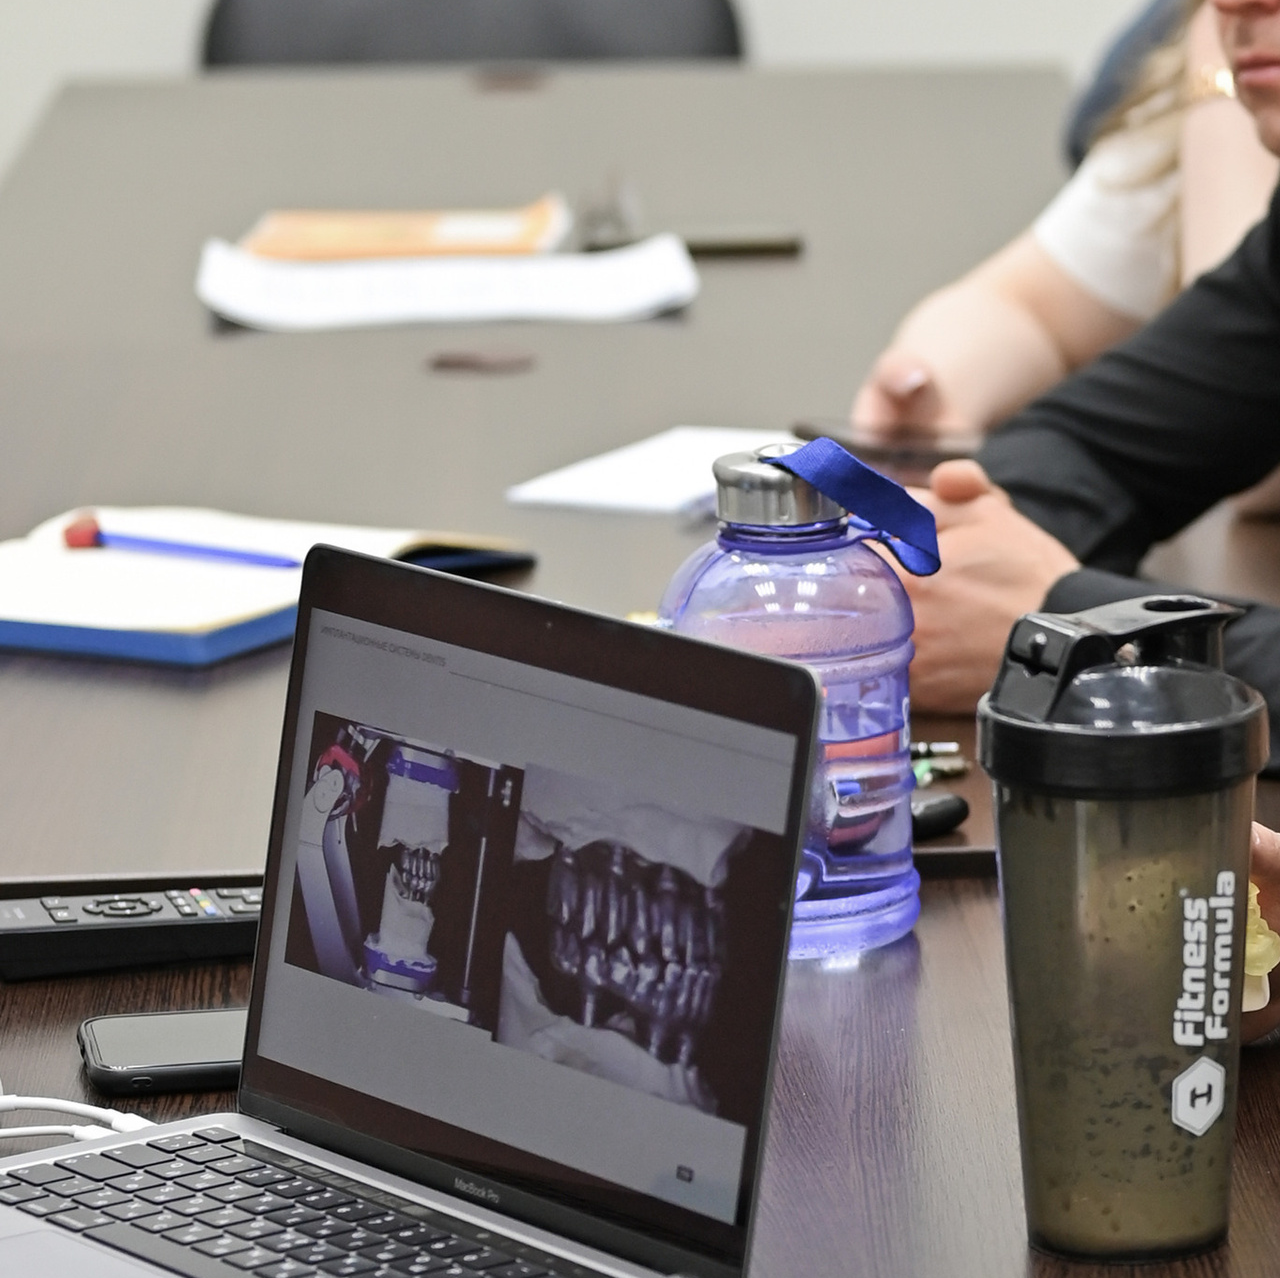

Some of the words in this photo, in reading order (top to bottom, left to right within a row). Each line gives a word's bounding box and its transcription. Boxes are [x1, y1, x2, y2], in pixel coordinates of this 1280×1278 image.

[1173, 898, 1208, 1046] Fitness
[1205, 870, 1235, 1040] Formula
[454, 1177, 486, 1198] MacBook
